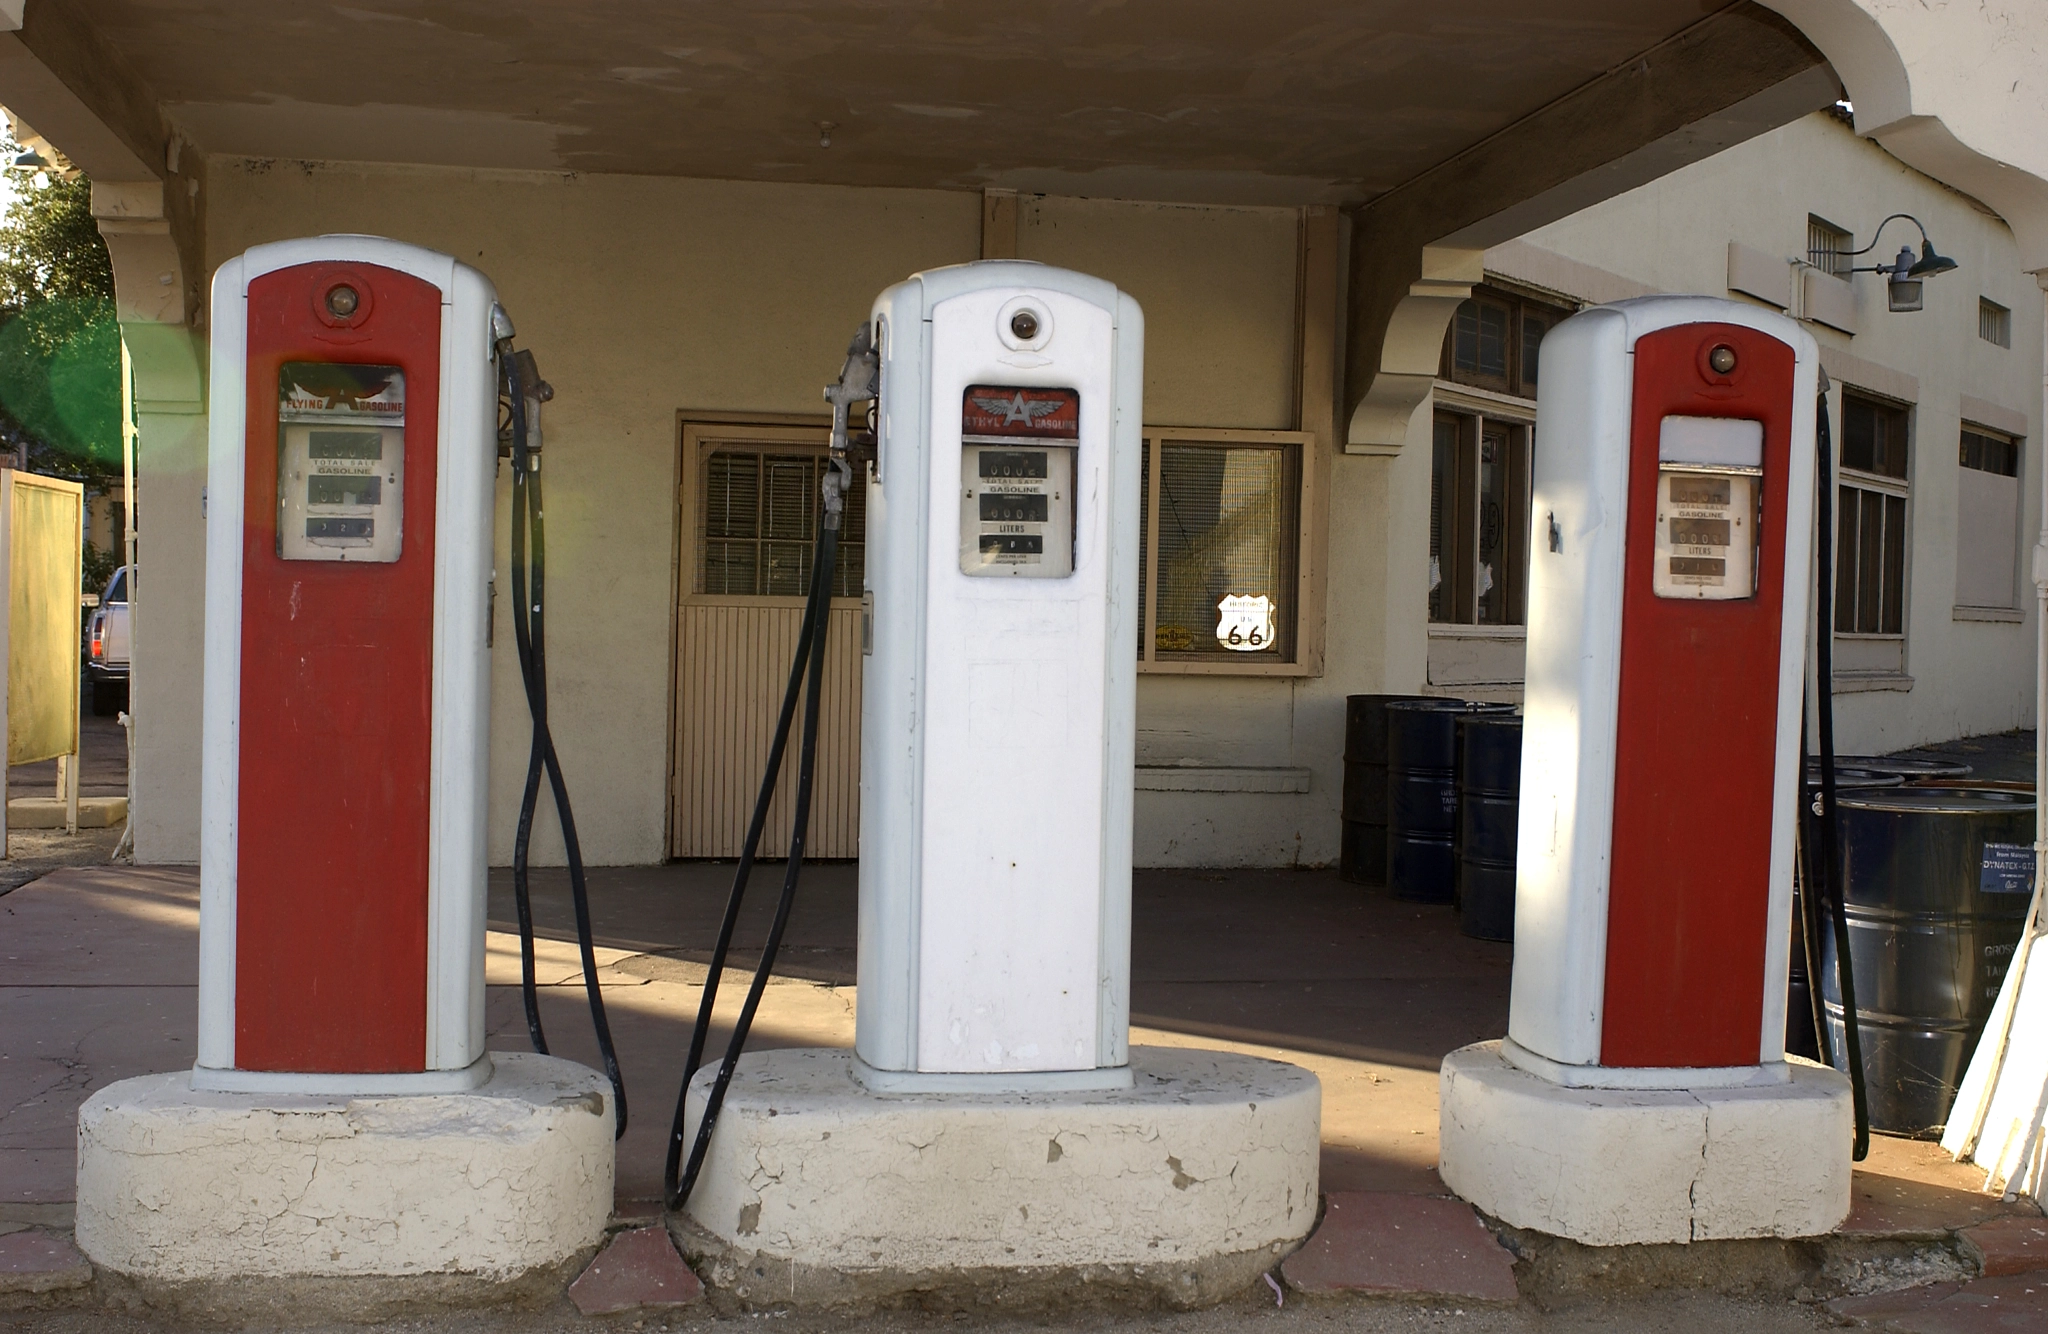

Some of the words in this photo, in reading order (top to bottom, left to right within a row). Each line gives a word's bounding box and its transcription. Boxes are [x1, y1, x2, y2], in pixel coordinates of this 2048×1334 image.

[286, 399, 323, 410] FLYING
[360, 401, 403, 413] GASOLINE
[964, 416, 1000, 428] ETHYL
[1034, 419, 1077, 430] GASOLINE
[314, 459, 345, 467] TOTAL
[318, 467, 372, 475] GASOLINE
[999, 525, 1025, 533] LITERS
[1688, 547, 1712, 555] LITERS
[1228, 624, 1263, 646] 66
[1443, 805, 1457, 813] NET
[1983, 860, 2018, 870] DYNATEX
[1984, 943, 2016, 957] GROSS
[1985, 986, 2000, 998] NE
